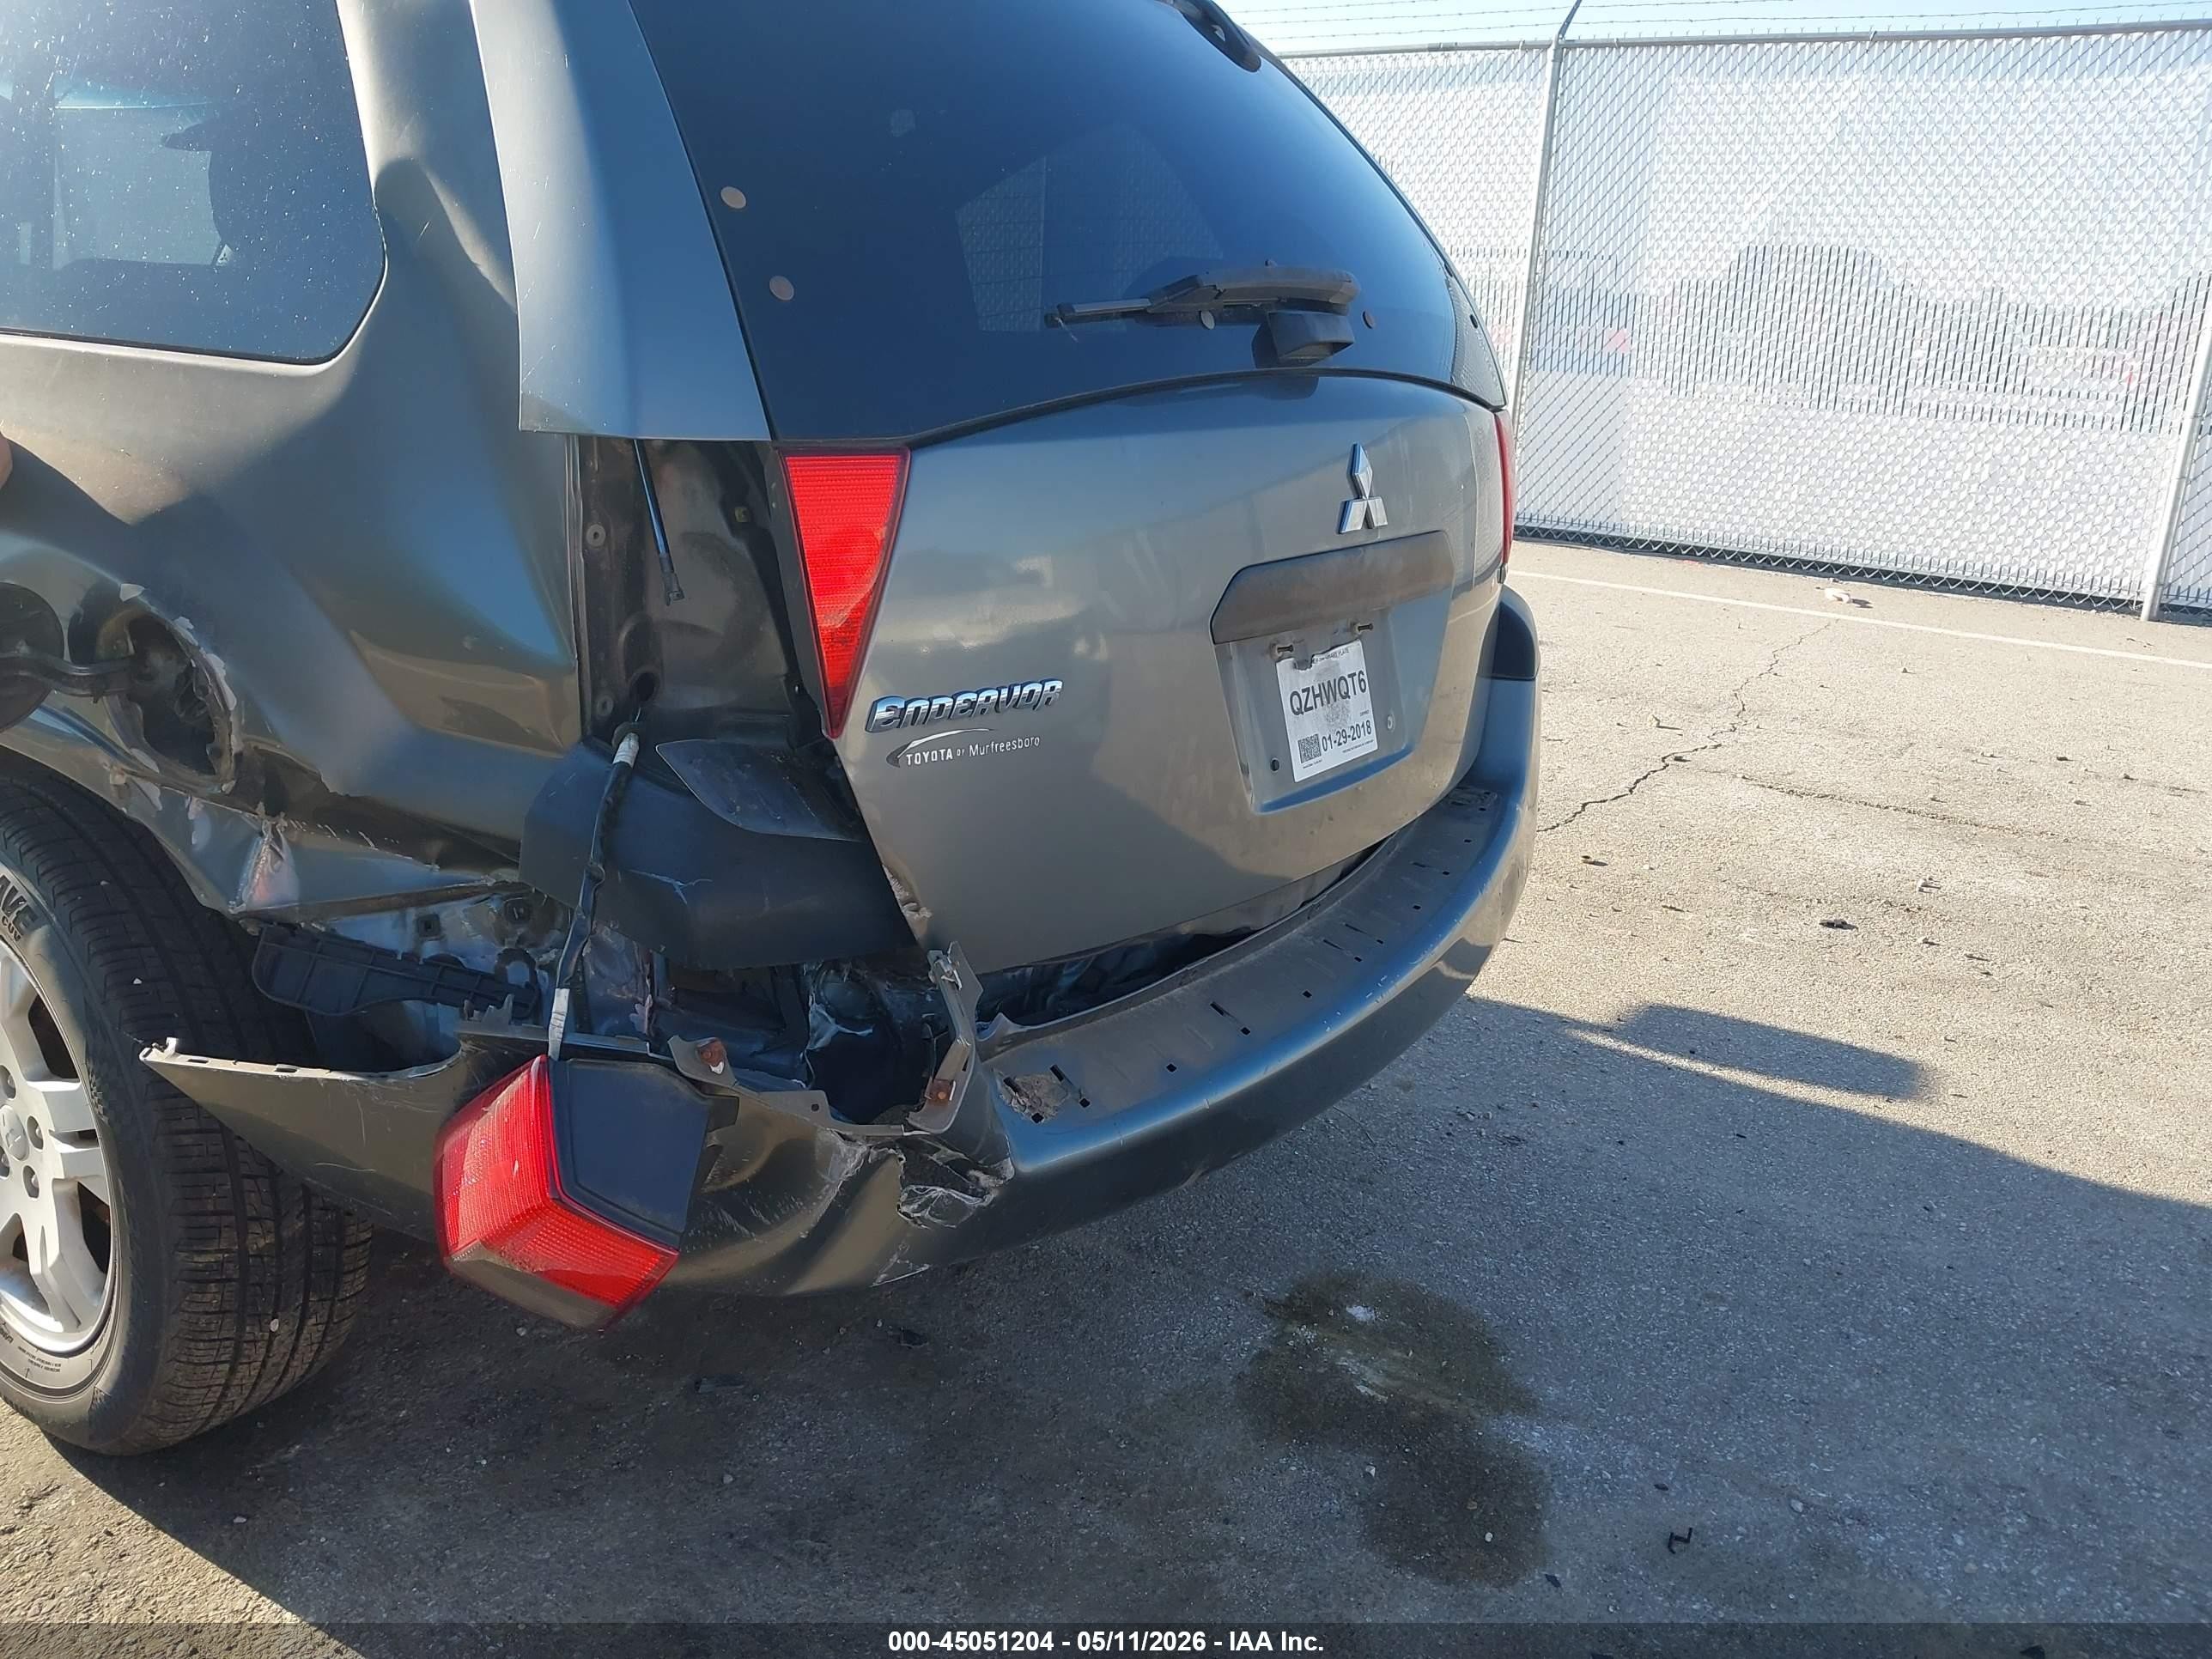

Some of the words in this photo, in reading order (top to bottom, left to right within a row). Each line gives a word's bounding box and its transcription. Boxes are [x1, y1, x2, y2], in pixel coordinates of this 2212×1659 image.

[866, 679, 1063, 732] ENDEAVOR
[1290, 670, 1367, 715] QZHWQT6
[906, 748, 953, 765] TOYOTA
[969, 736, 1041, 757] Murfreesboro
[1322, 720, 1372, 751] 01-29-2018
